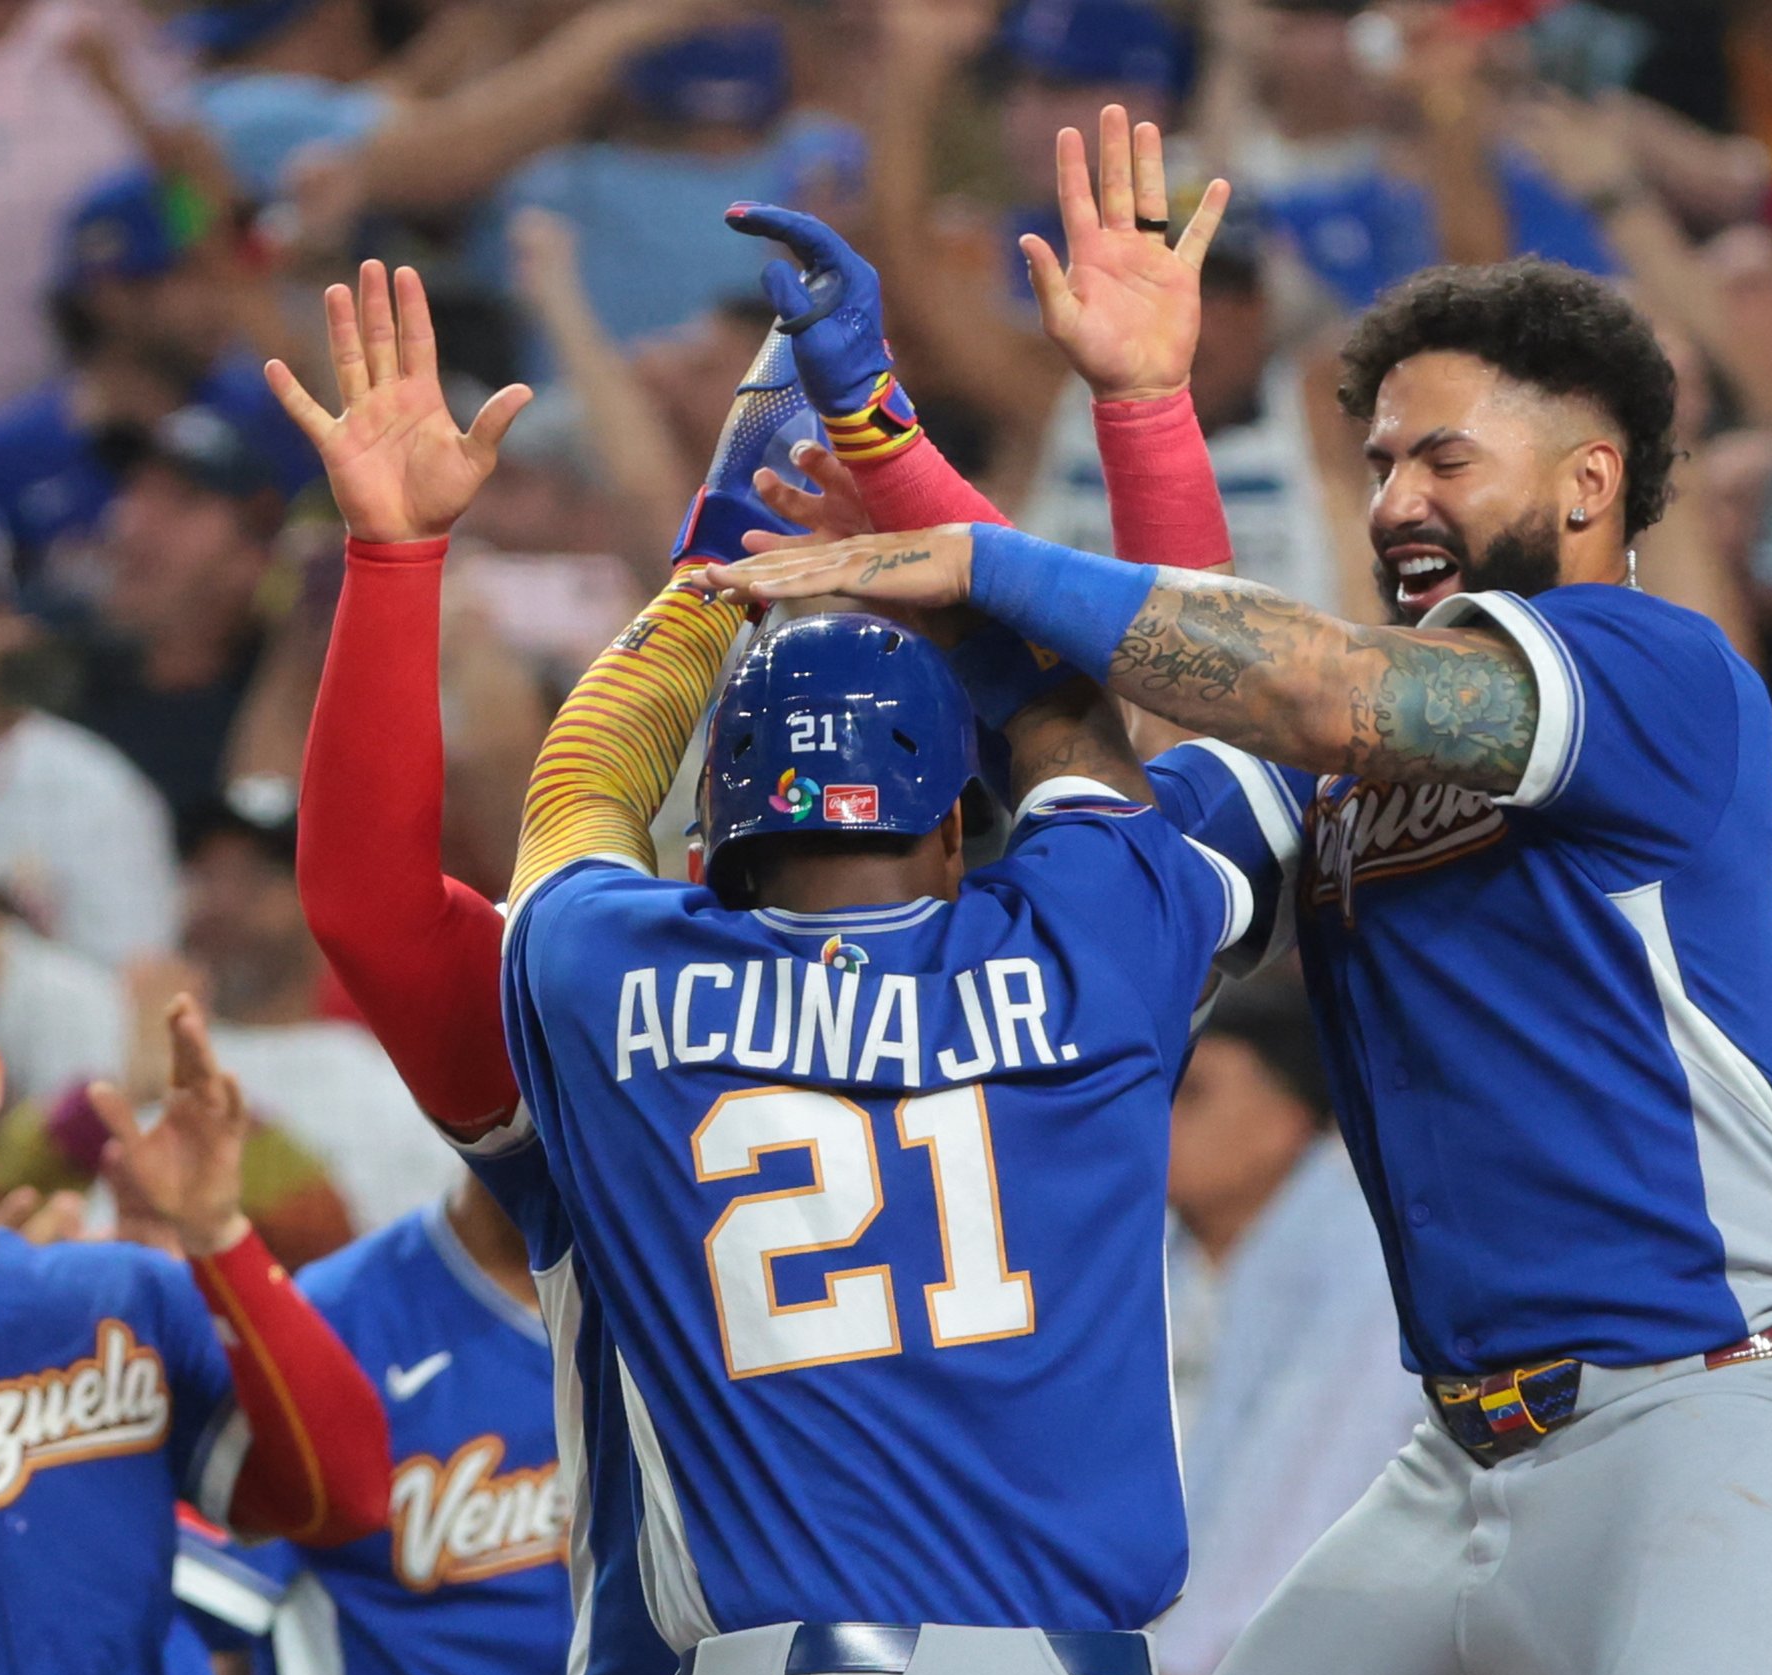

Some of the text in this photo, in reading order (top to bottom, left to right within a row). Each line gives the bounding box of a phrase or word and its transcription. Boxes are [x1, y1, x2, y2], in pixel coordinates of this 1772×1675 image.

[789, 713, 837, 753] 21
[936, 957, 1079, 1081] JR.
[690, 1083, 1035, 1381] 21
